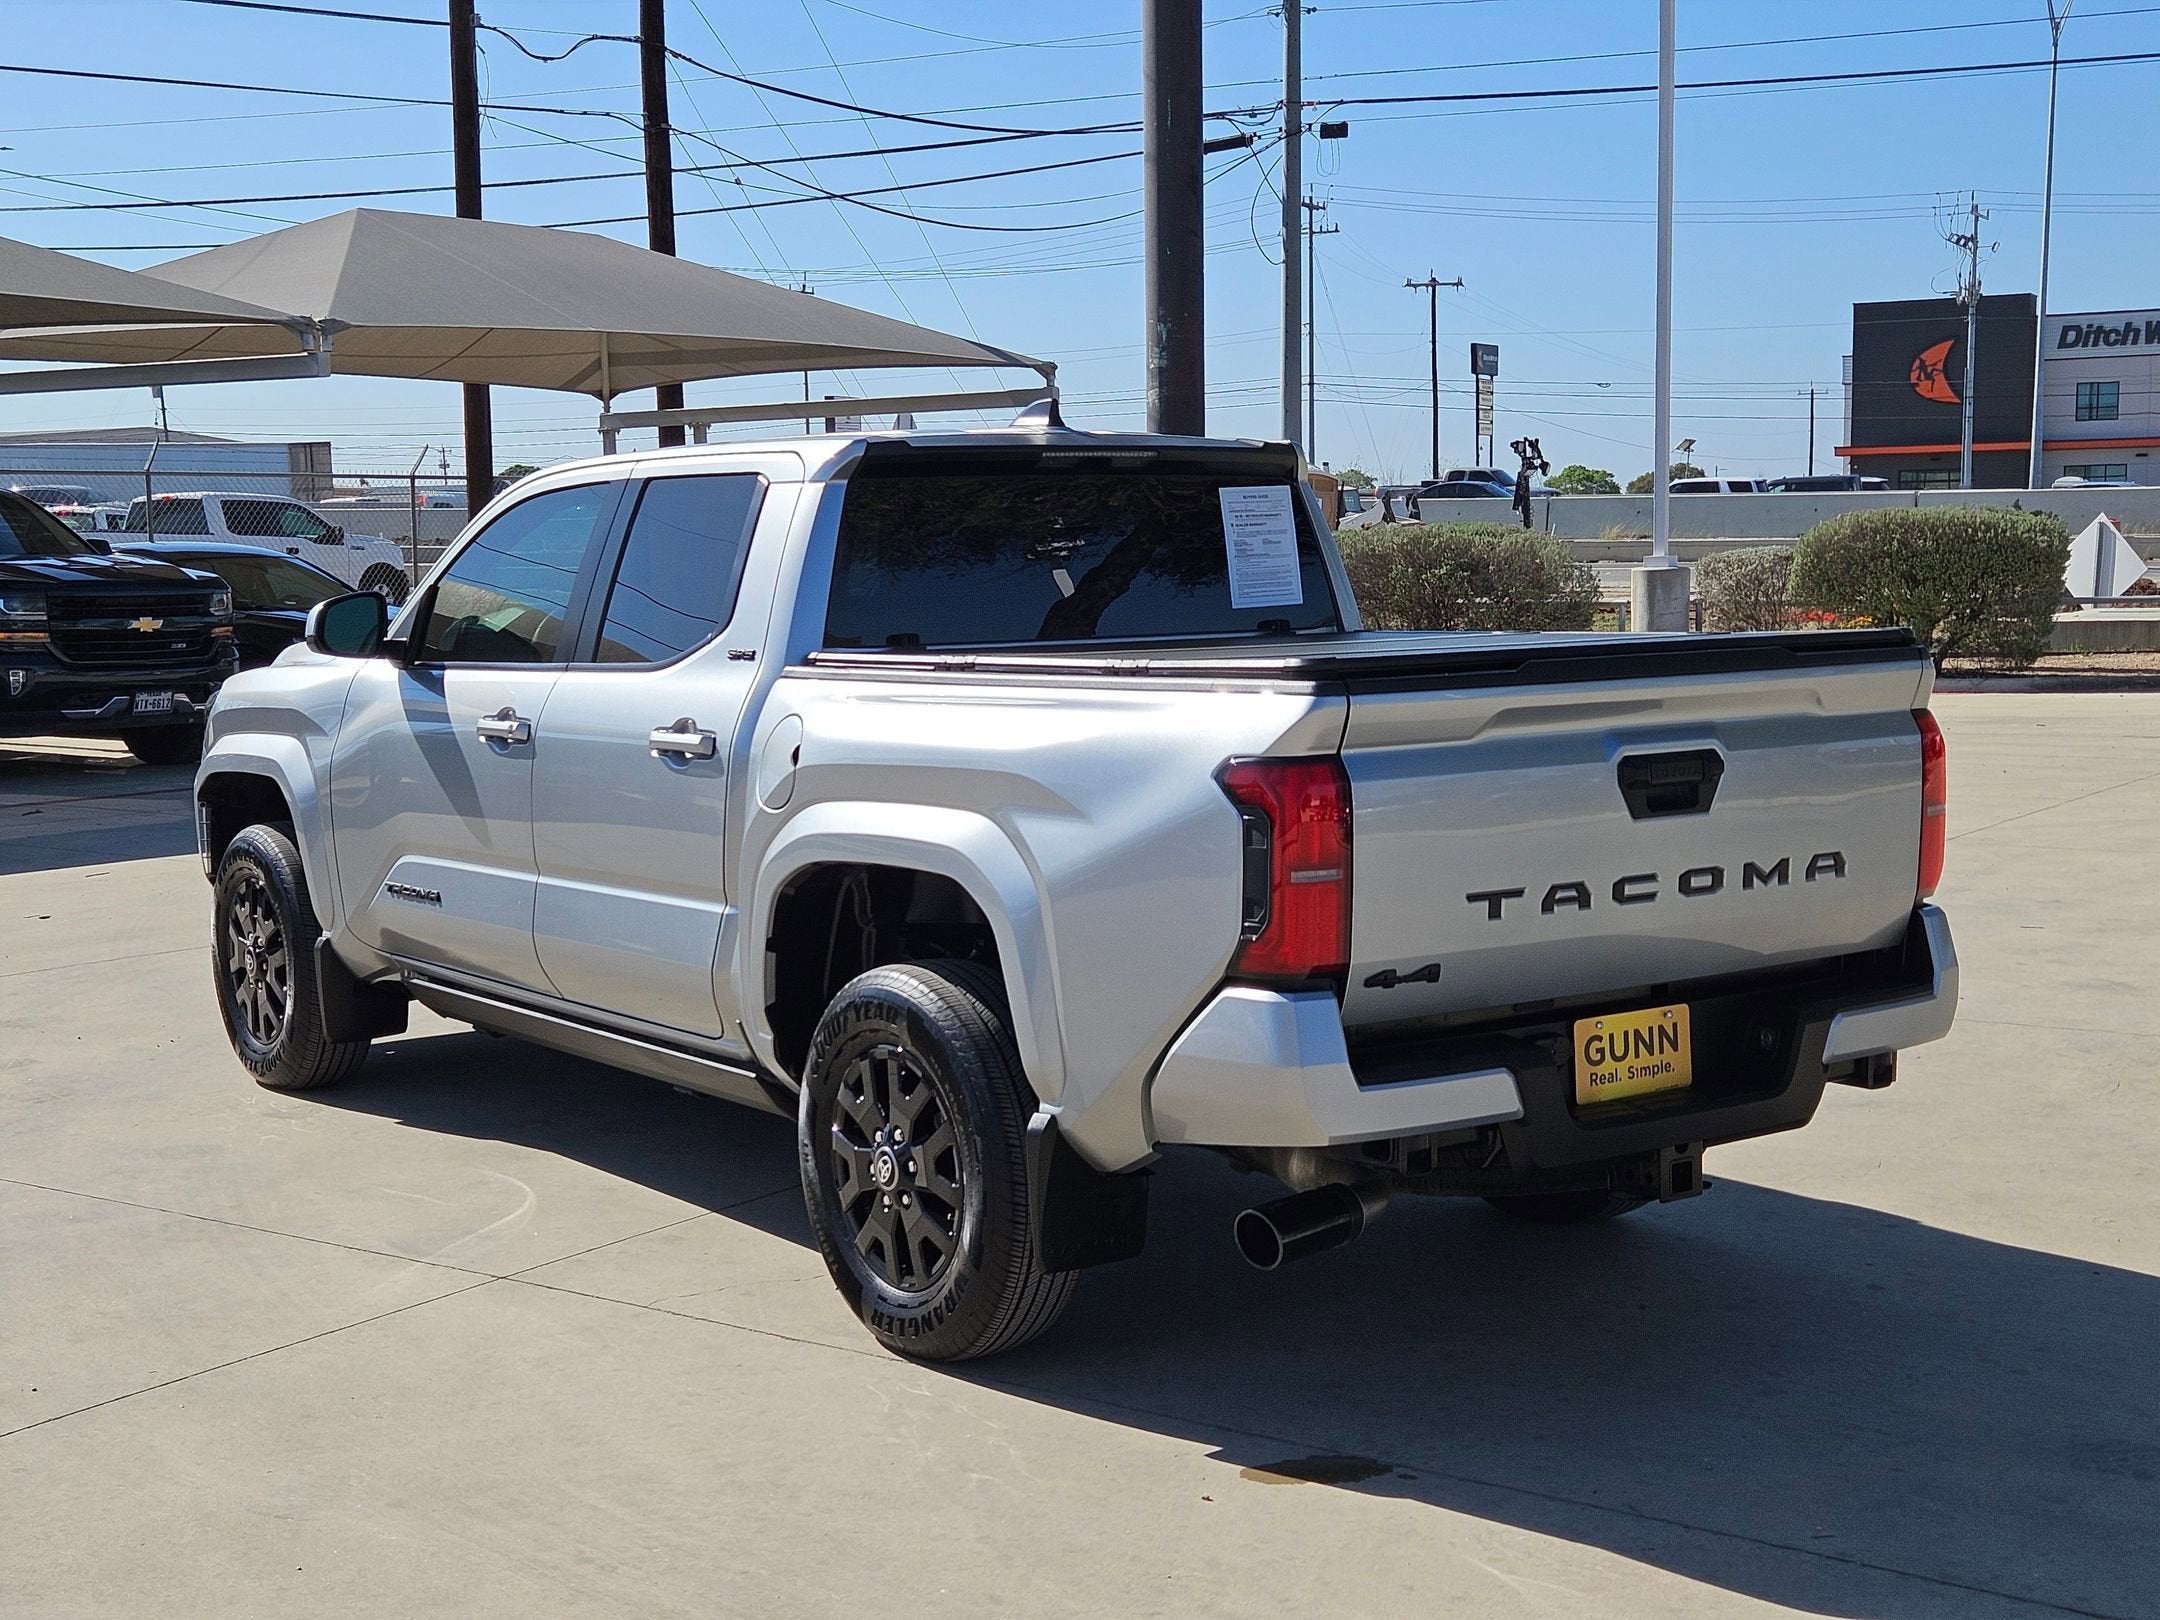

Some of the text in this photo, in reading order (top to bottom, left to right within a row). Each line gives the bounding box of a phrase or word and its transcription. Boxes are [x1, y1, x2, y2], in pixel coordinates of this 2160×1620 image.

[2057, 322, 2140, 349] Ditch
[385, 882, 442, 905] TACOMA
[1466, 851, 1847, 920] TACOMA
[1584, 1021, 1679, 1067] GUNN
[1589, 1060, 1675, 1087] Real. Simple.
